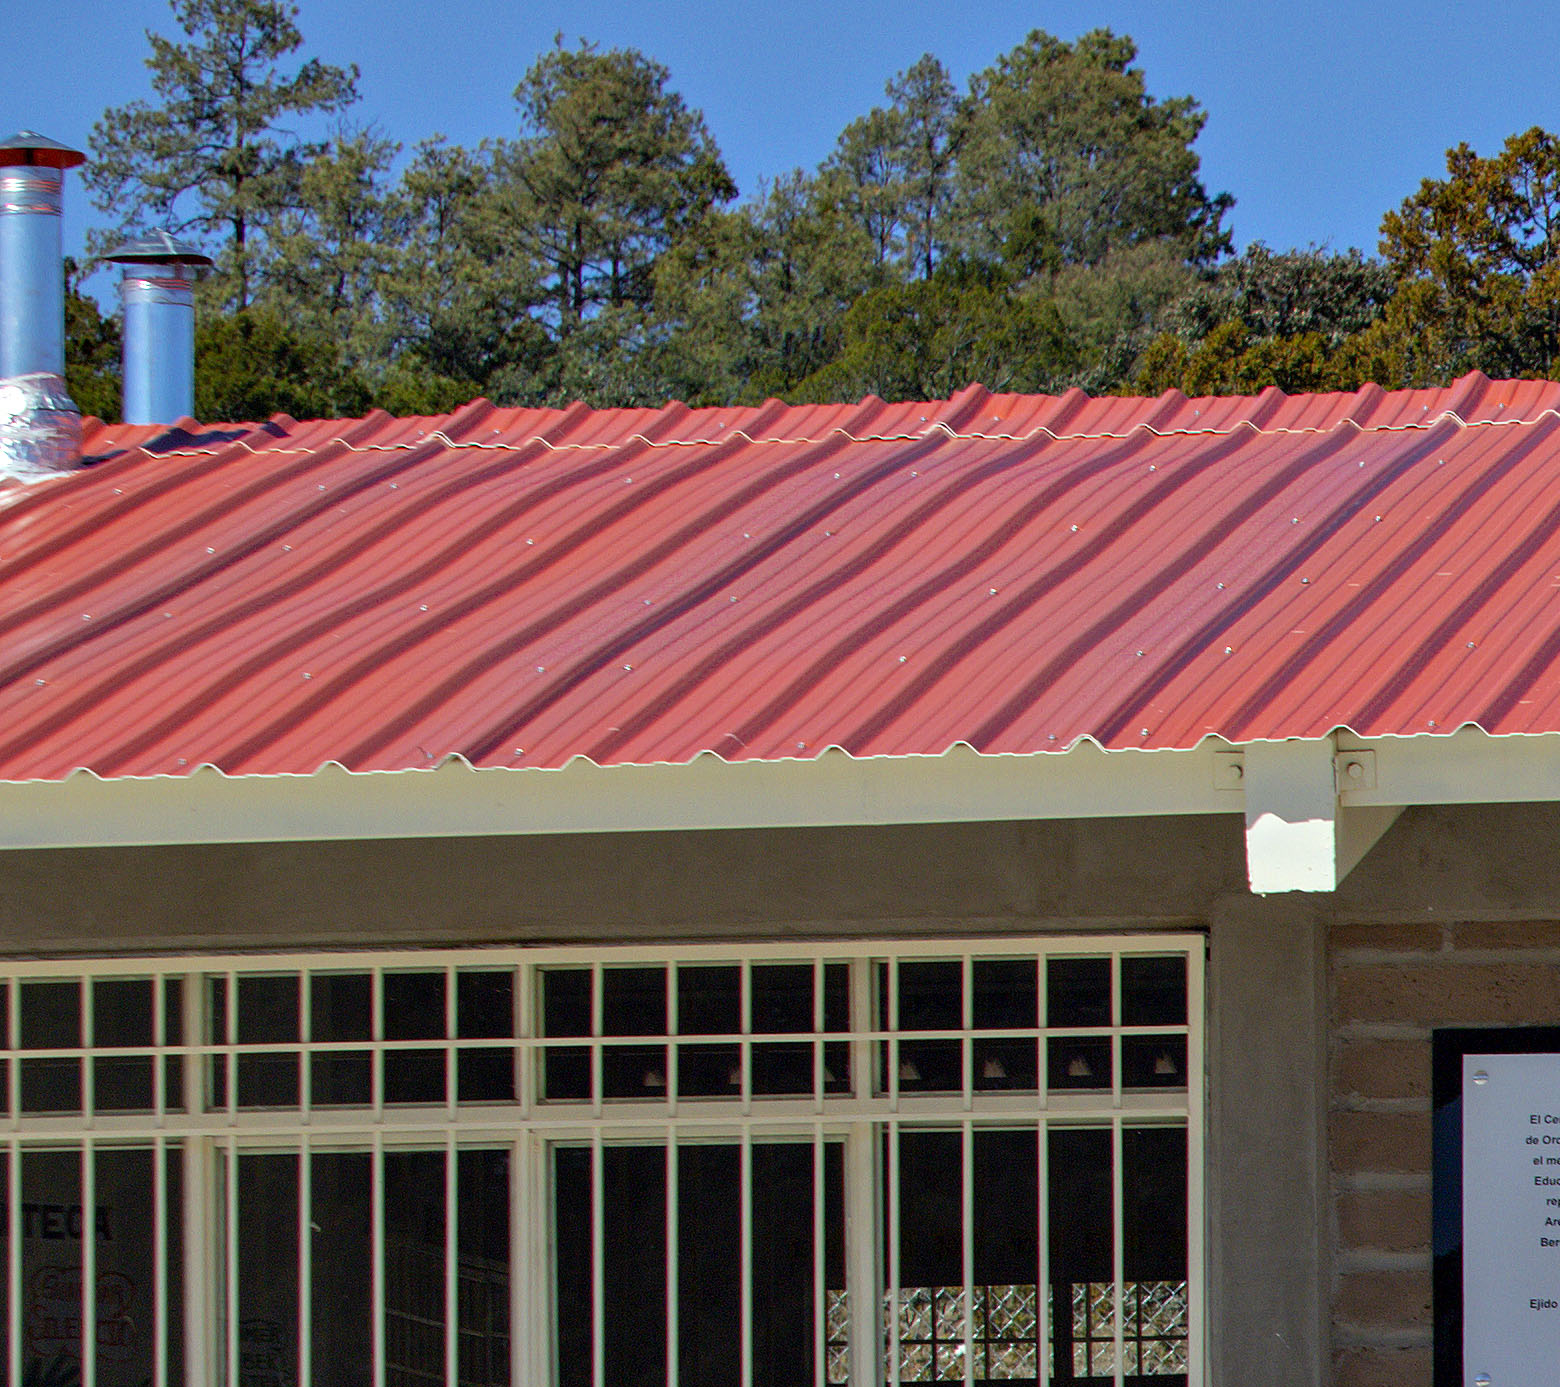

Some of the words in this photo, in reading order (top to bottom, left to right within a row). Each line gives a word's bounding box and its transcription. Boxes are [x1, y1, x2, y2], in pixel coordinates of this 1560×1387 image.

[1528, 1114, 1540, 1124] El
[1525, 1136, 1539, 1144] de
[1532, 1156, 1543, 1165] el
[1528, 1299, 1558, 1311] Ejido
